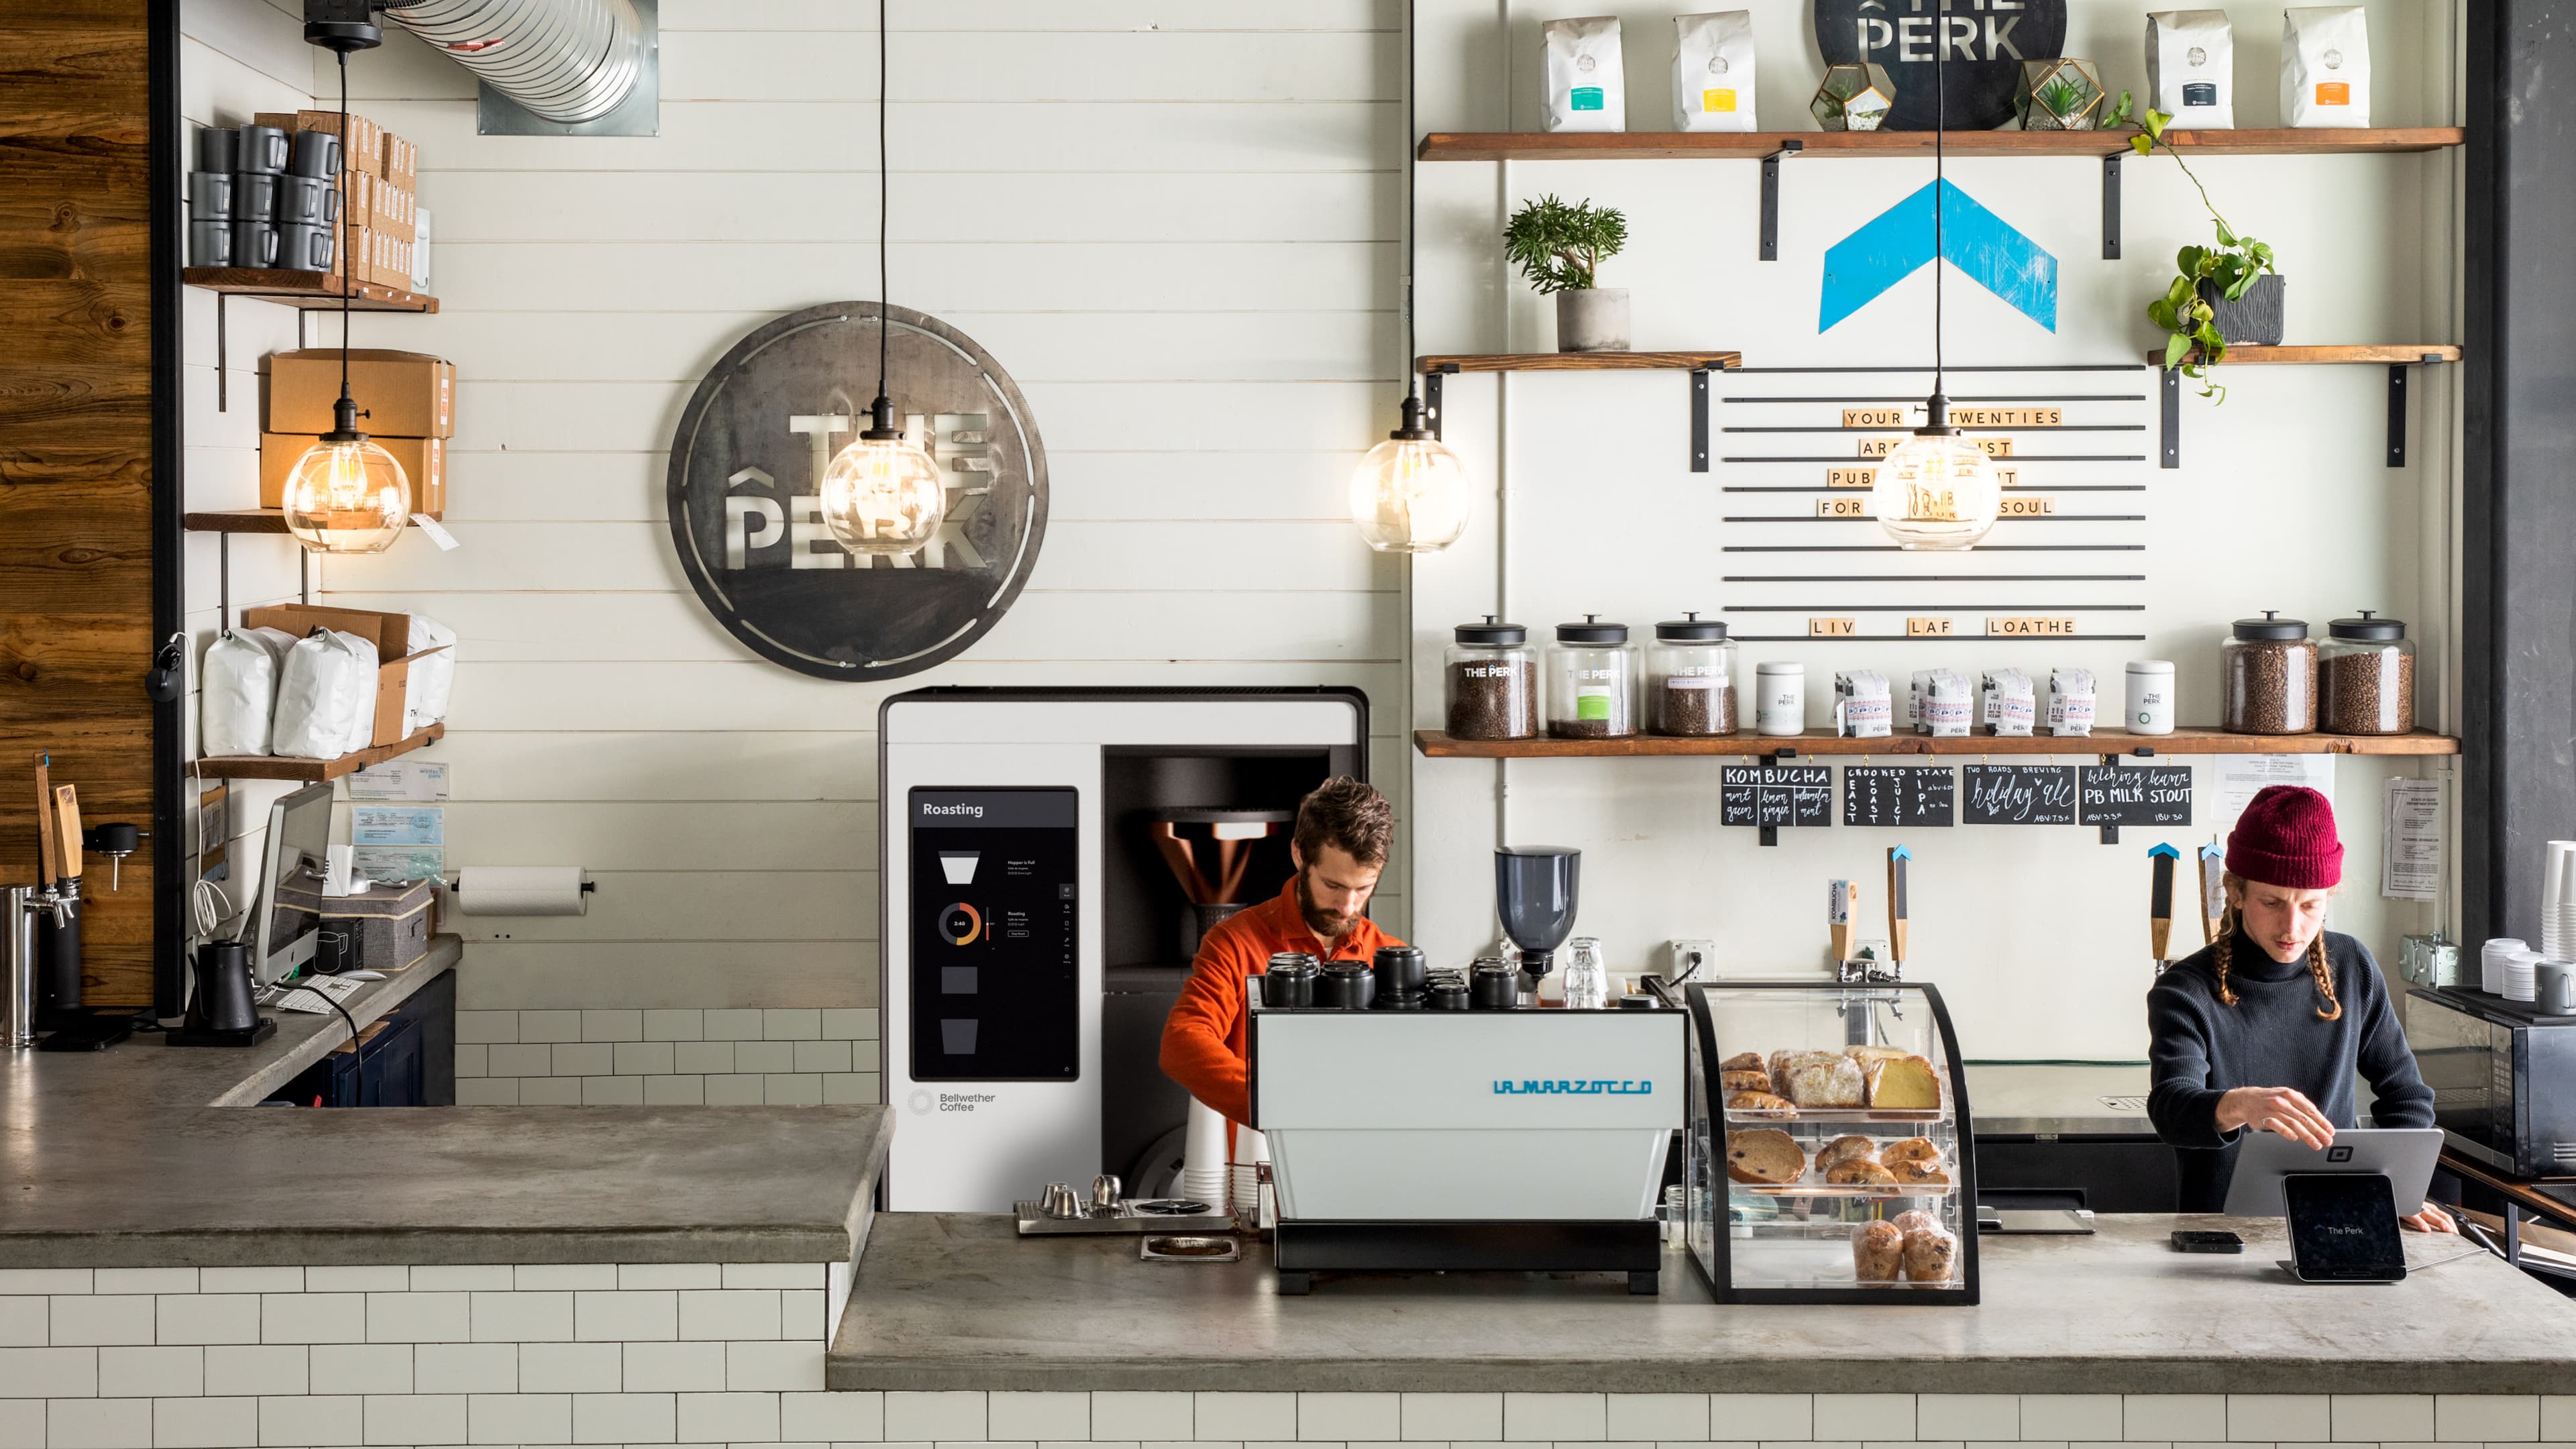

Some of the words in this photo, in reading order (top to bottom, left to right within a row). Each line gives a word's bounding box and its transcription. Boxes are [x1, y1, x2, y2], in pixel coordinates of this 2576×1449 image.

[1857, 17, 2023, 62] PERK
[1847, 412, 1901, 424] YOUR
[1948, 411, 2059, 423] TWENTIES
[1822, 502, 1860, 514] FOR
[2000, 501, 2052, 513] SOUL
[1814, 621, 1853, 633] LIV
[1912, 621, 1949, 633] LAF
[1991, 621, 2074, 633] LOATHE
[1464, 667, 1487, 678] THE
[1488, 666, 1517, 678] PERK
[1697, 665, 1725, 676] PERK
[1725, 768, 1828, 784] KOMBUCHA
[1847, 768, 1906, 777] CROOKED
[1760, 790, 1788, 804] lemon
[1971, 774, 2039, 821] holiday
[2043, 776, 2076, 808] ale
[2085, 789, 2105, 804] PB
[2110, 788, 2143, 804] MILK
[2150, 788, 2192, 804] STOUT
[923, 803, 983, 818] Roasting
[1763, 805, 1790, 821] ginger
[1494, 1080, 1513, 1094] LA
[1523, 1080, 1652, 1094] MARZOCCO
[940, 1093, 996, 1102] Bellwether
[940, 1103, 974, 1111] Coffee
[2326, 1226, 2343, 1234] The
[2345, 1226, 2363, 1234] Perk
